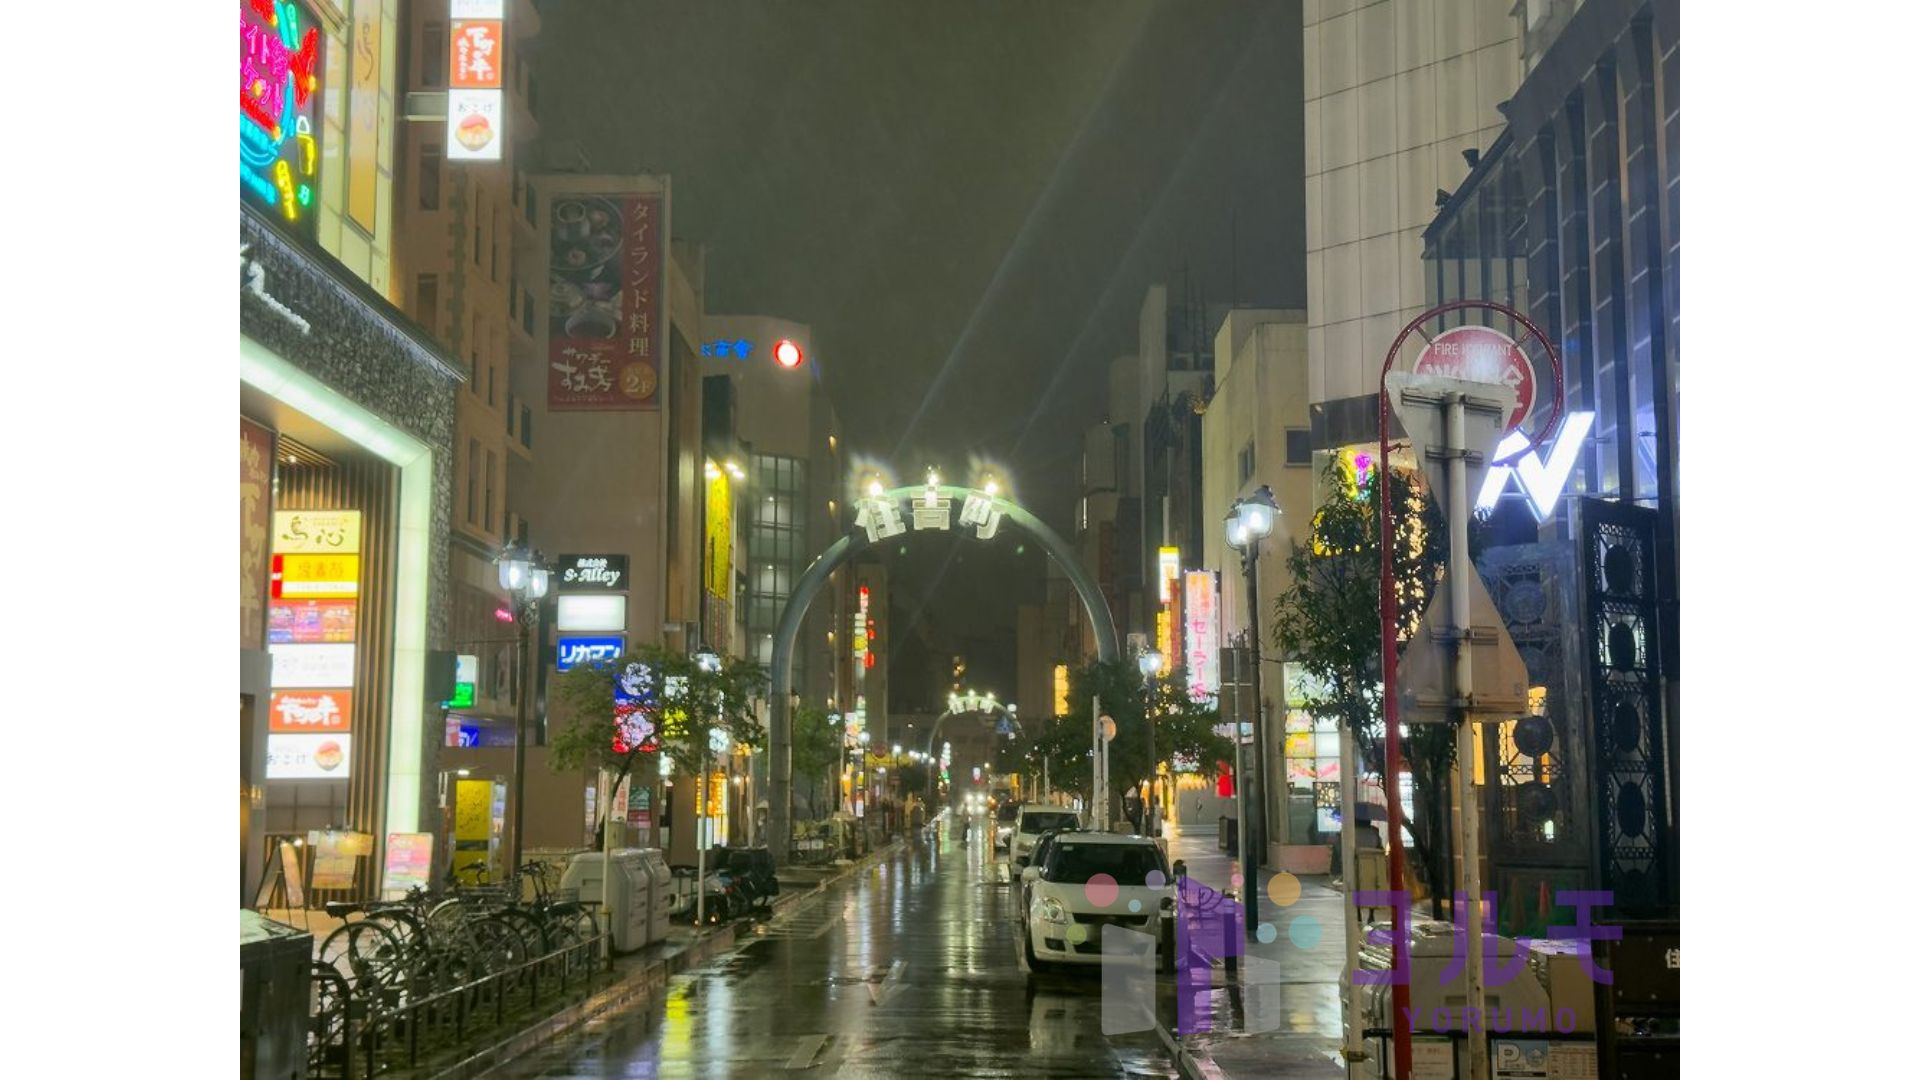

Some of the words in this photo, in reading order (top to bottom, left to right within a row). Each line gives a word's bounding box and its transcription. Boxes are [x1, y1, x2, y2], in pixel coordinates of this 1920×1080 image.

[629, 202, 650, 359] タイランド料理
[1434, 343, 1460, 356] FIRE
[625, 374, 650, 394] 2F
[854, 488, 1002, 544] 住吉町
[560, 644, 622, 664] リカマン
